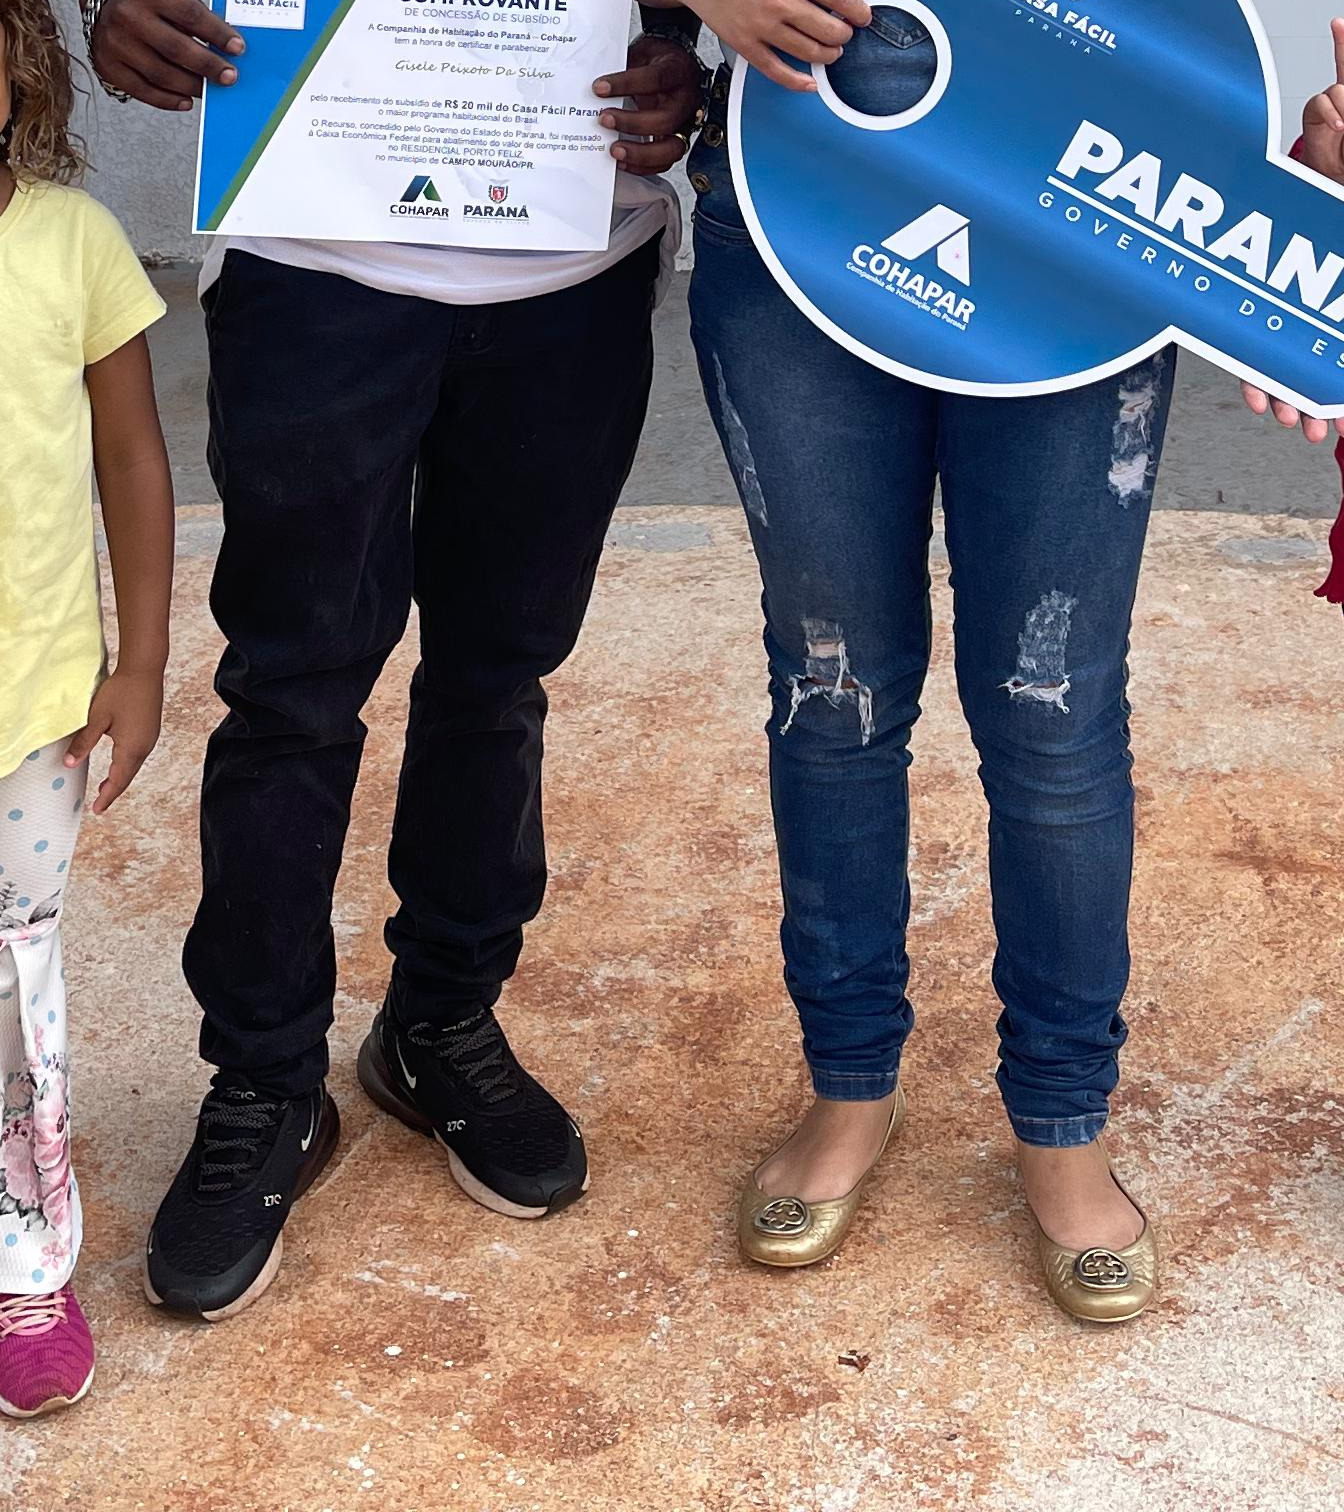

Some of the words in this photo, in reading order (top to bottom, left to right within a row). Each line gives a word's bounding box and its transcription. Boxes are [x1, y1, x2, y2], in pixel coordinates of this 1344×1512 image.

[405, 7, 419, 17] DE
[422, 8, 489, 20] CONCESSÃO
[493, 13, 507, 22] DE
[511, 13, 561, 24] SUBSÍDIO
[368, 23, 374, 31] A
[377, 24, 427, 34] Companhia
[442, 28, 485, 38] Habitação
[501, 31, 531, 40] Paraná
[541, 33, 577, 44] Cohapar
[1063, 12, 1117, 50] FÁCIL
[395, 59, 438, 72] Gisele
[441, 63, 492, 75] Peixoto
[495, 66, 516, 76] Da
[518, 67, 555, 79] Silva
[383, 97, 393, 105] do
[432, 100, 442, 108] de
[444, 99, 459, 109] R$
[462, 101, 474, 109] 20
[477, 102, 492, 111] mil
[496, 102, 508, 112] do
[512, 103, 538, 113] Casa
[541, 105, 566, 115] Fácil
[401, 144, 461, 155] RESIDENCIAL
[463, 148, 495, 157] PORTO
[442, 158, 475, 167] CAMPO
[390, 205, 449, 217] COHAPAR
[464, 205, 529, 218] PARANÁ
[1038, 192, 1211, 292] GOVERNO
[1238, 299, 1283, 331] DO
[852, 244, 975, 323] COHAPAR
